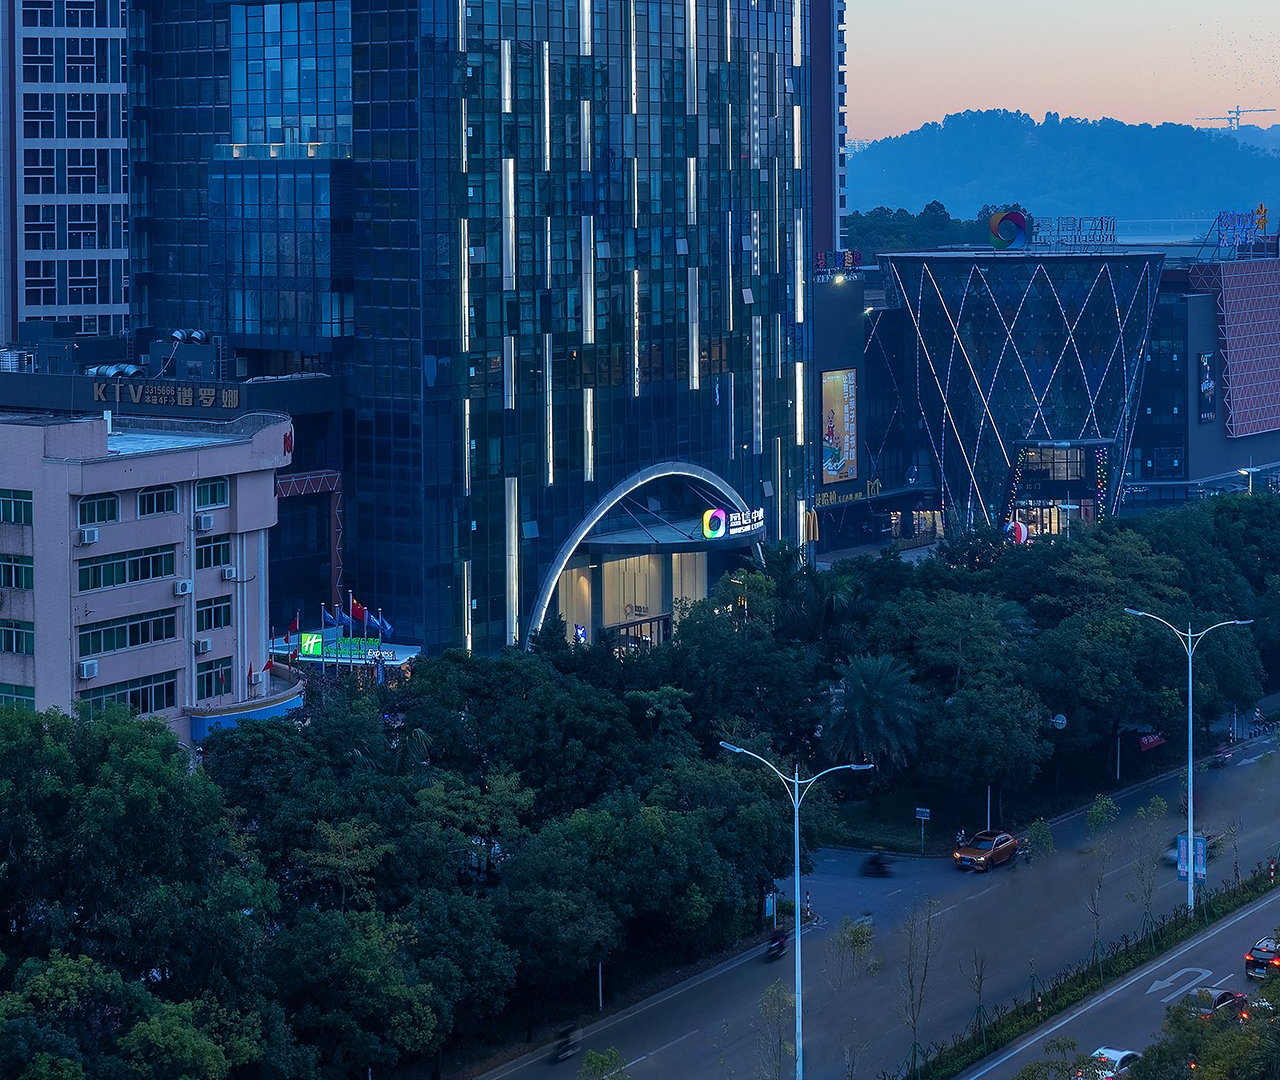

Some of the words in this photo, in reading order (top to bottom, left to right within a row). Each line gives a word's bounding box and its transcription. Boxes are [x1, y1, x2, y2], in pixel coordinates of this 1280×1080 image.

[94, 383, 143, 404] KTV
[177, 387, 239, 408] 谱罗娜
[145, 385, 175, 395] 3315666
[368, 649, 393, 660] Express
